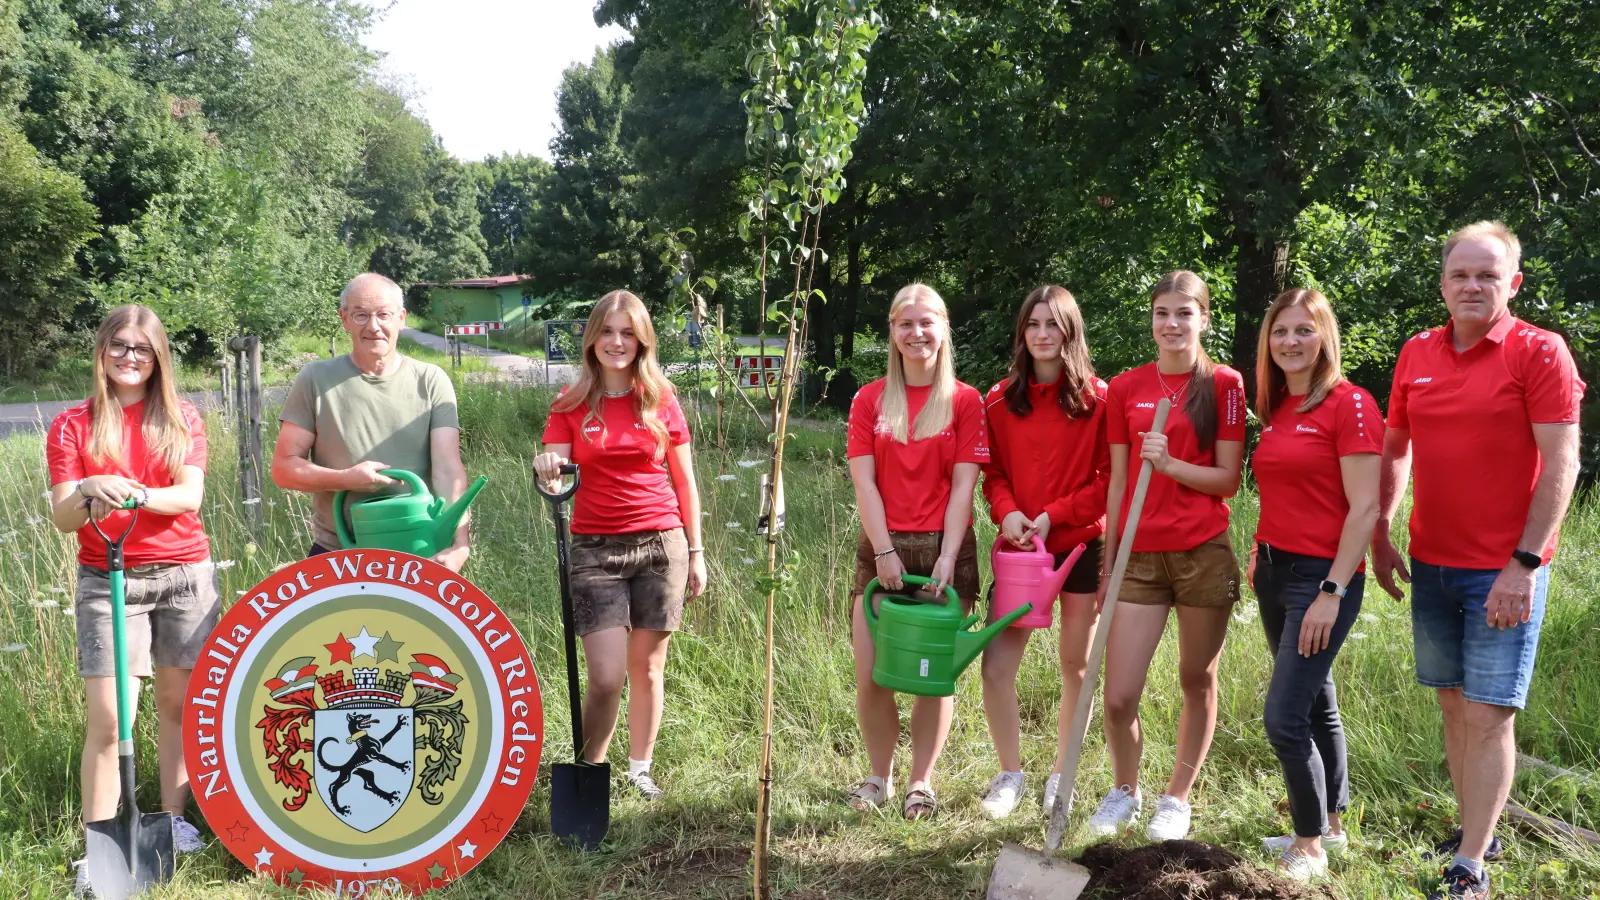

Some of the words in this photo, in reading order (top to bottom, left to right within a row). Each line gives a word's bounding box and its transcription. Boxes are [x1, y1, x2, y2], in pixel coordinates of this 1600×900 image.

[192, 624, 253, 801] Narrhalla
[247, 553, 512, 652] Rot-Weiß-Gold
[499, 654, 536, 787] Rieden
